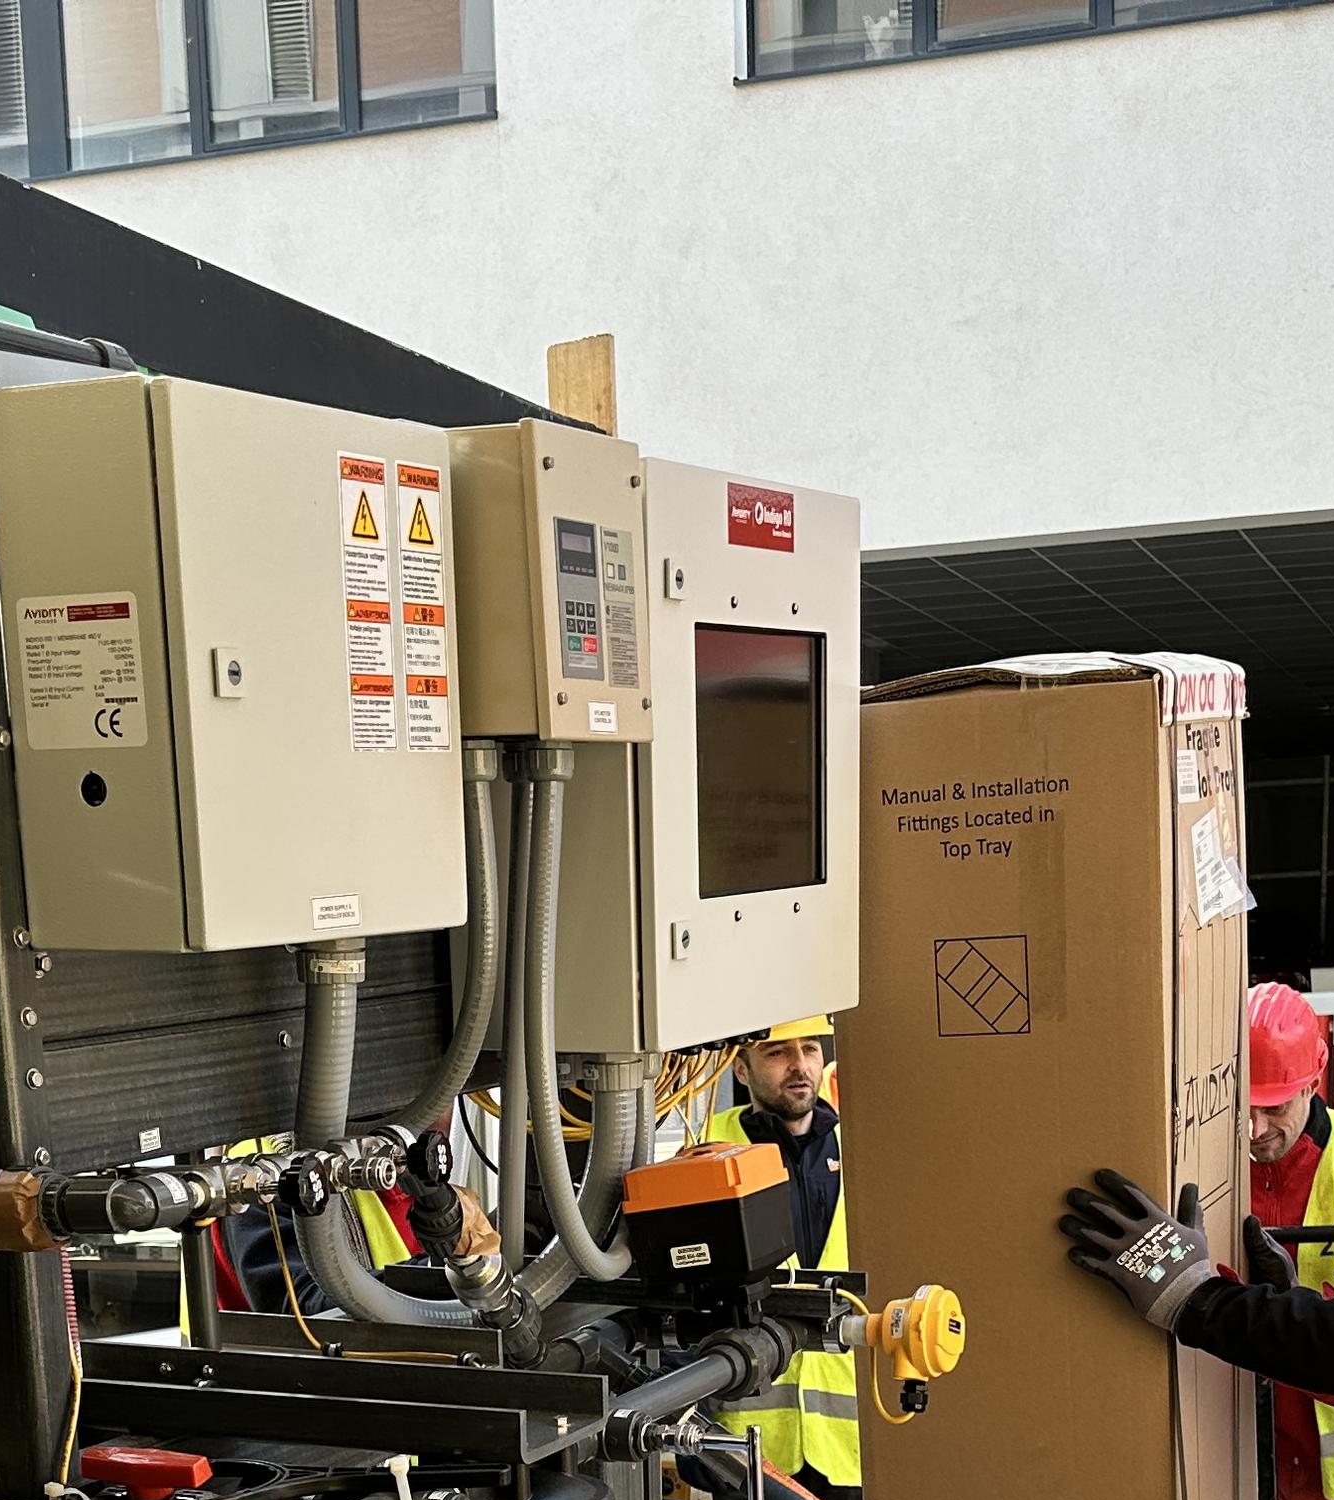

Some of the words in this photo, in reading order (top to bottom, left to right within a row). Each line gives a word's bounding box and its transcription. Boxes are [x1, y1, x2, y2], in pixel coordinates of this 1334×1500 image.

[24, 607, 65, 619] AVIDITY
[1185, 723, 1221, 757] Fragile
[881, 784, 946, 806] Manual
[952, 782, 966, 801] &
[971, 776, 1070, 799] Installation
[897, 811, 960, 833] Fittings
[965, 807, 1033, 829] Located
[1038, 805, 1055, 823] in
[940, 840, 972, 860] Top
[975, 838, 1013, 858] Tray
[1183, 1054, 1238, 1162] AVIDITY
